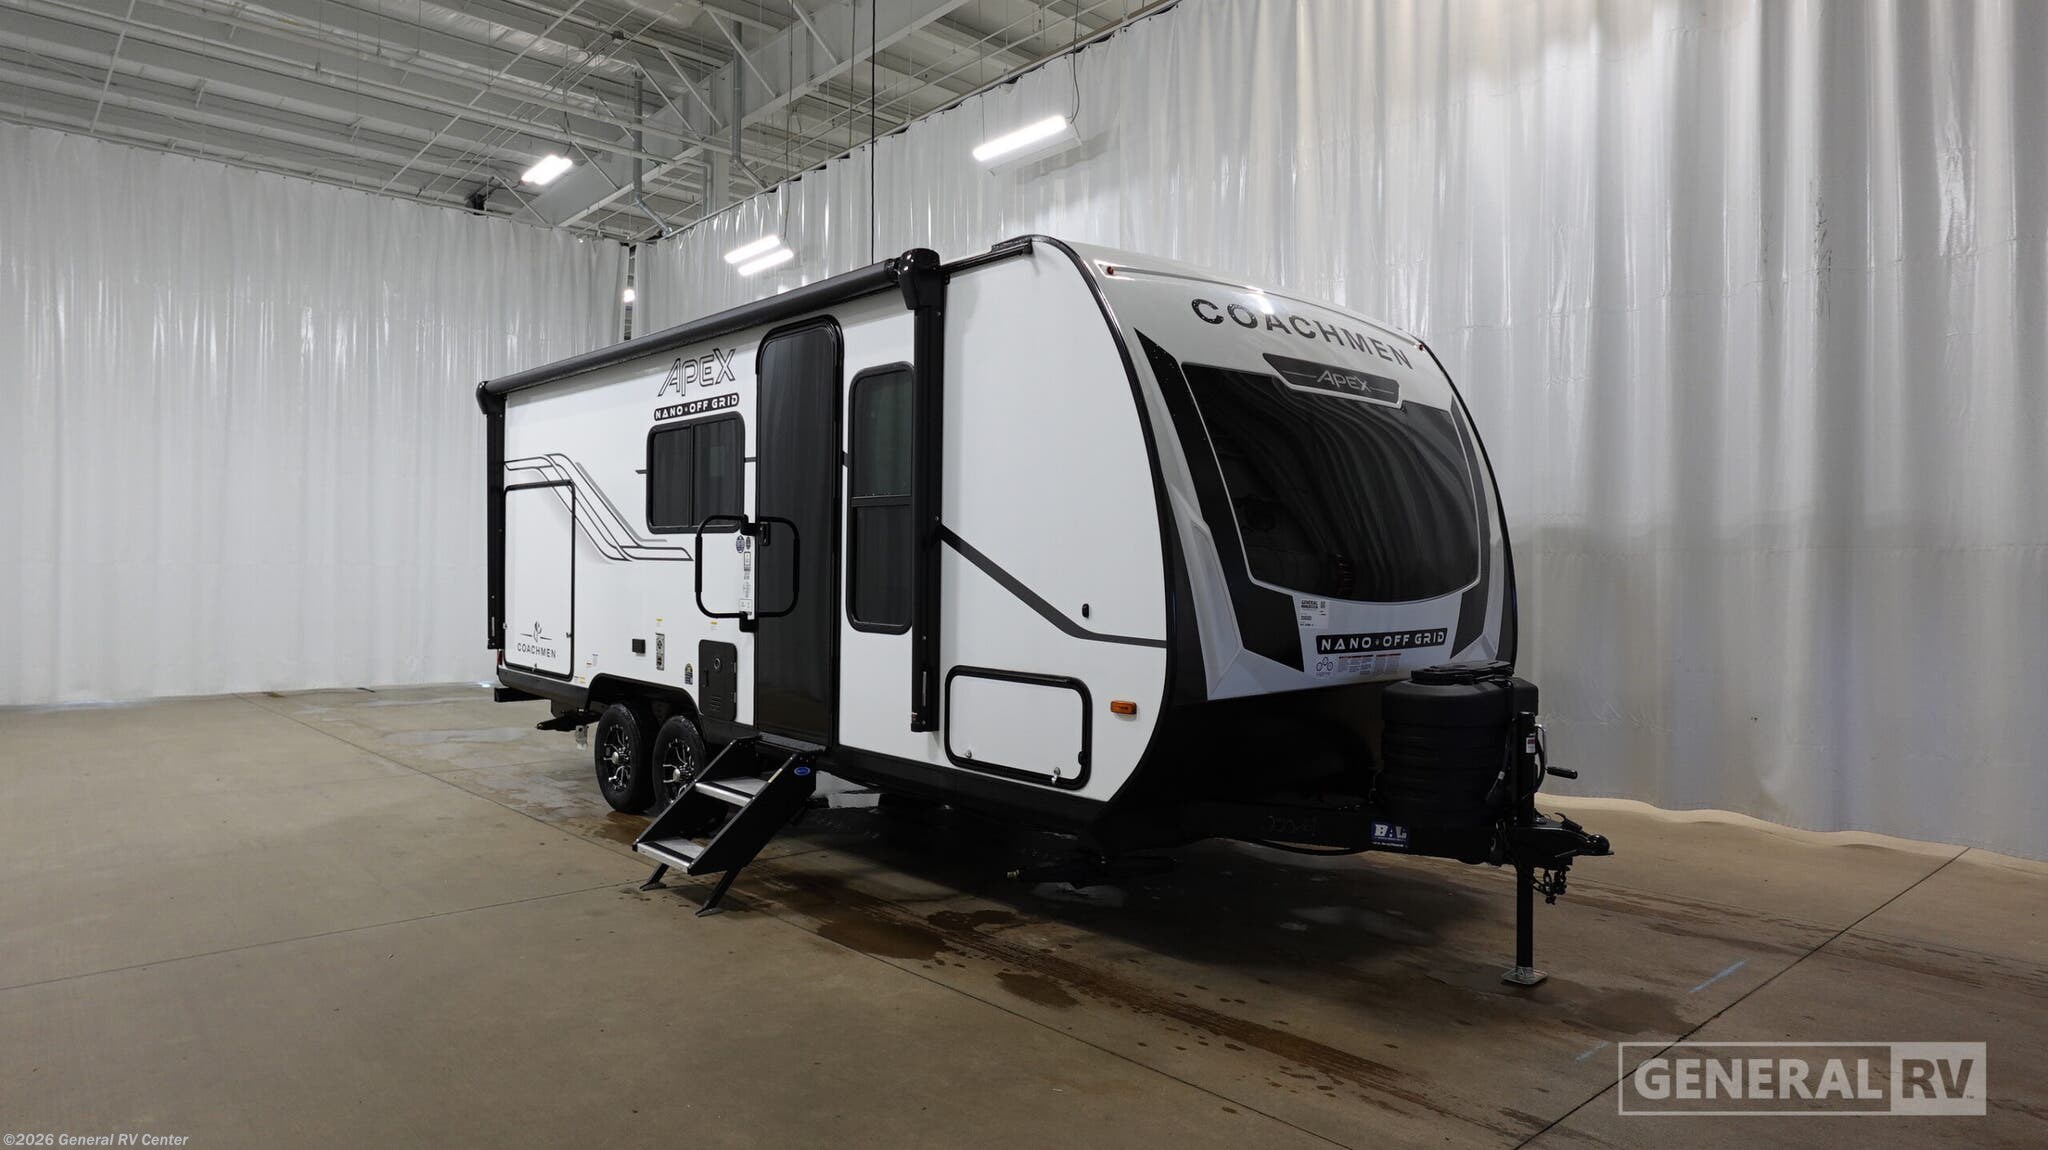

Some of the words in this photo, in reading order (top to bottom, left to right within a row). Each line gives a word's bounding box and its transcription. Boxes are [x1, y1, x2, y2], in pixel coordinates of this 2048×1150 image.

[1191, 298, 1414, 370] COACHMEN
[711, 394, 739, 409] GRID
[1414, 631, 1446, 645] GRID
[517, 642, 557, 658] COACHMEN
